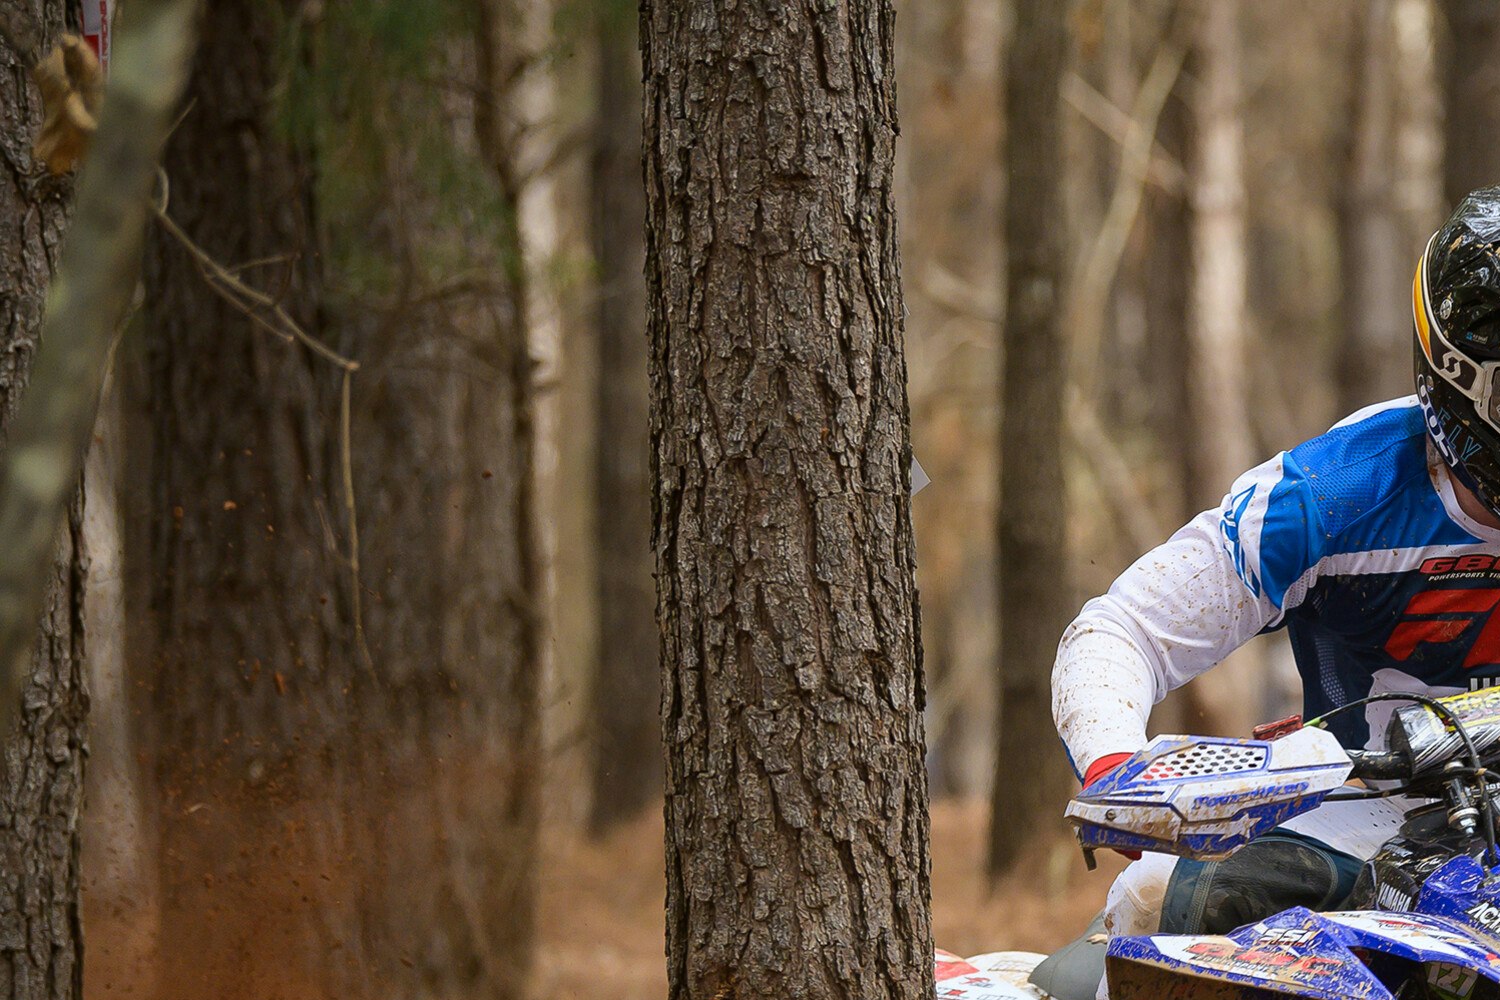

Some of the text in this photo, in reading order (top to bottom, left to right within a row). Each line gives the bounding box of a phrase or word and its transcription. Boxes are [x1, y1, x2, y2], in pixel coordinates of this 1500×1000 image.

[1428, 571, 1485, 581] POWERSPORTS
[1378, 881, 1412, 912] YAMAHA
[1427, 961, 1479, 997] 127
